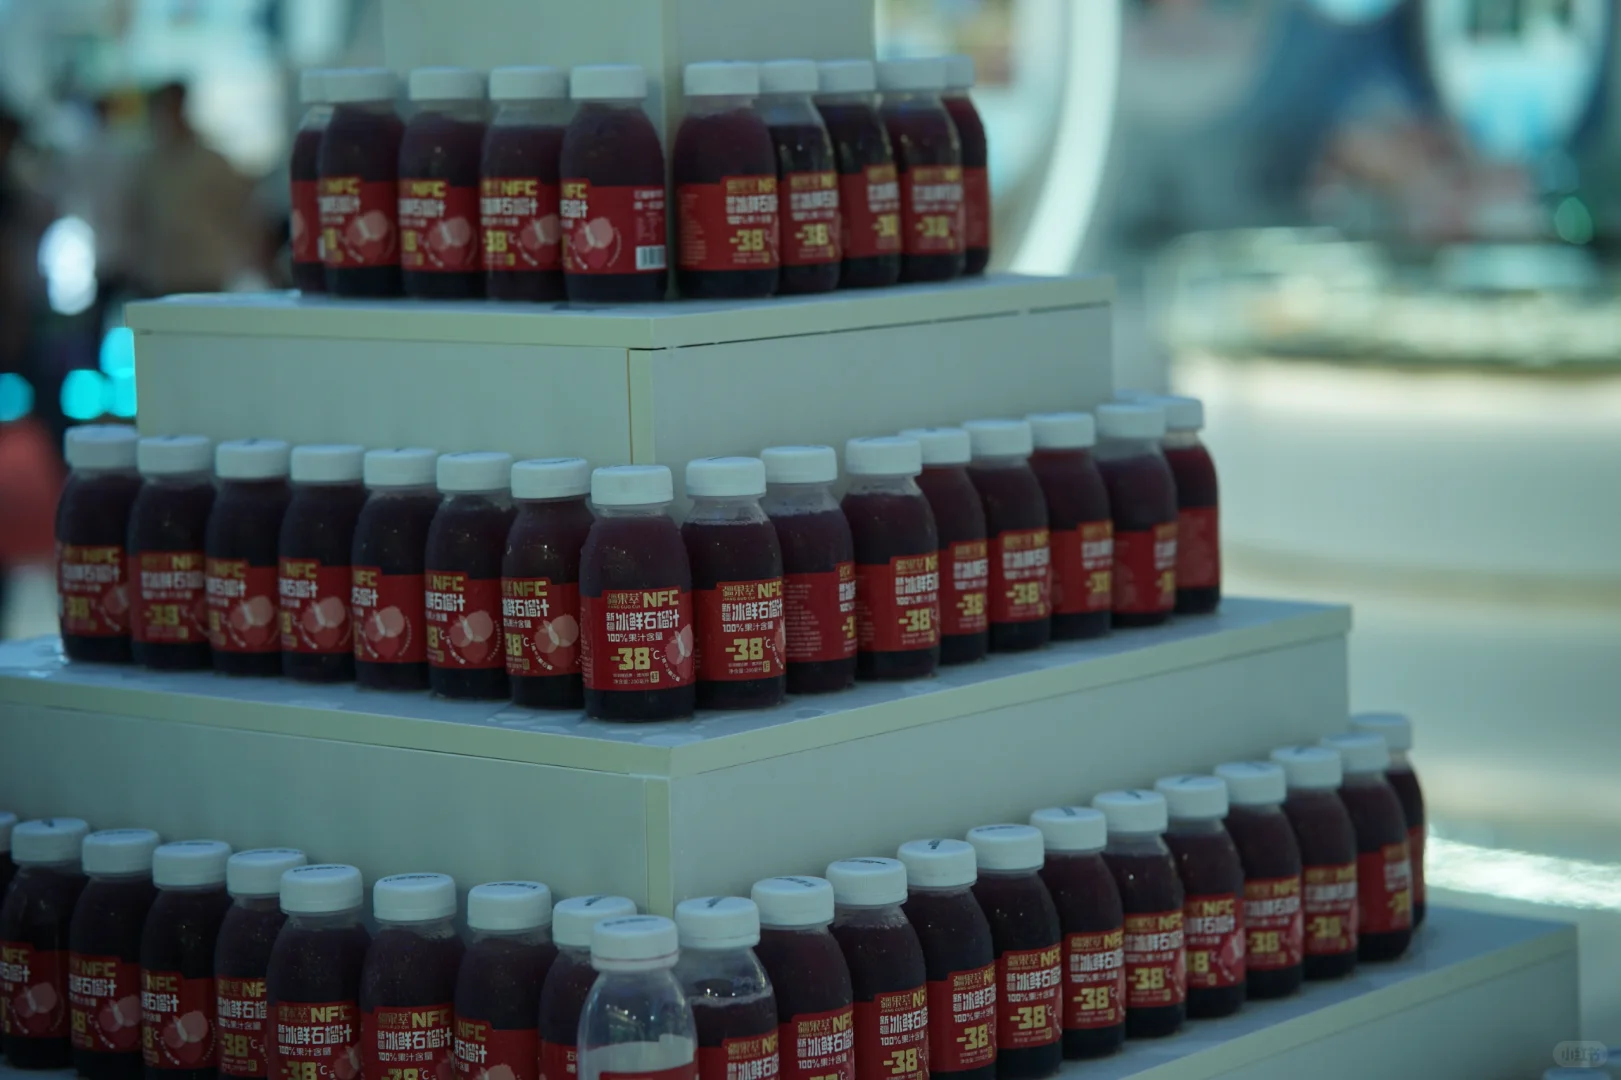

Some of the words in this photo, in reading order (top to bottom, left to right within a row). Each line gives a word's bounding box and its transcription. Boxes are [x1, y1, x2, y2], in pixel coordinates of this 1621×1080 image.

[433, 575, 465, 592] NFC
[513, 581, 548, 597] NFC
[643, 590, 679, 608] NFC
[615, 609, 680, 631] 冰鲜石榴汁
[722, 621, 774, 633] 100%果汁含量
[607, 632, 663, 643] 100%果汁含量
[81, 961, 116, 977] NFC
[146, 974, 178, 991] NFC
[242, 981, 267, 998] NF
[310, 1005, 352, 1023] NFC
[412, 1008, 449, 1028] NFC
[457, 1020, 487, 1041] NFC
